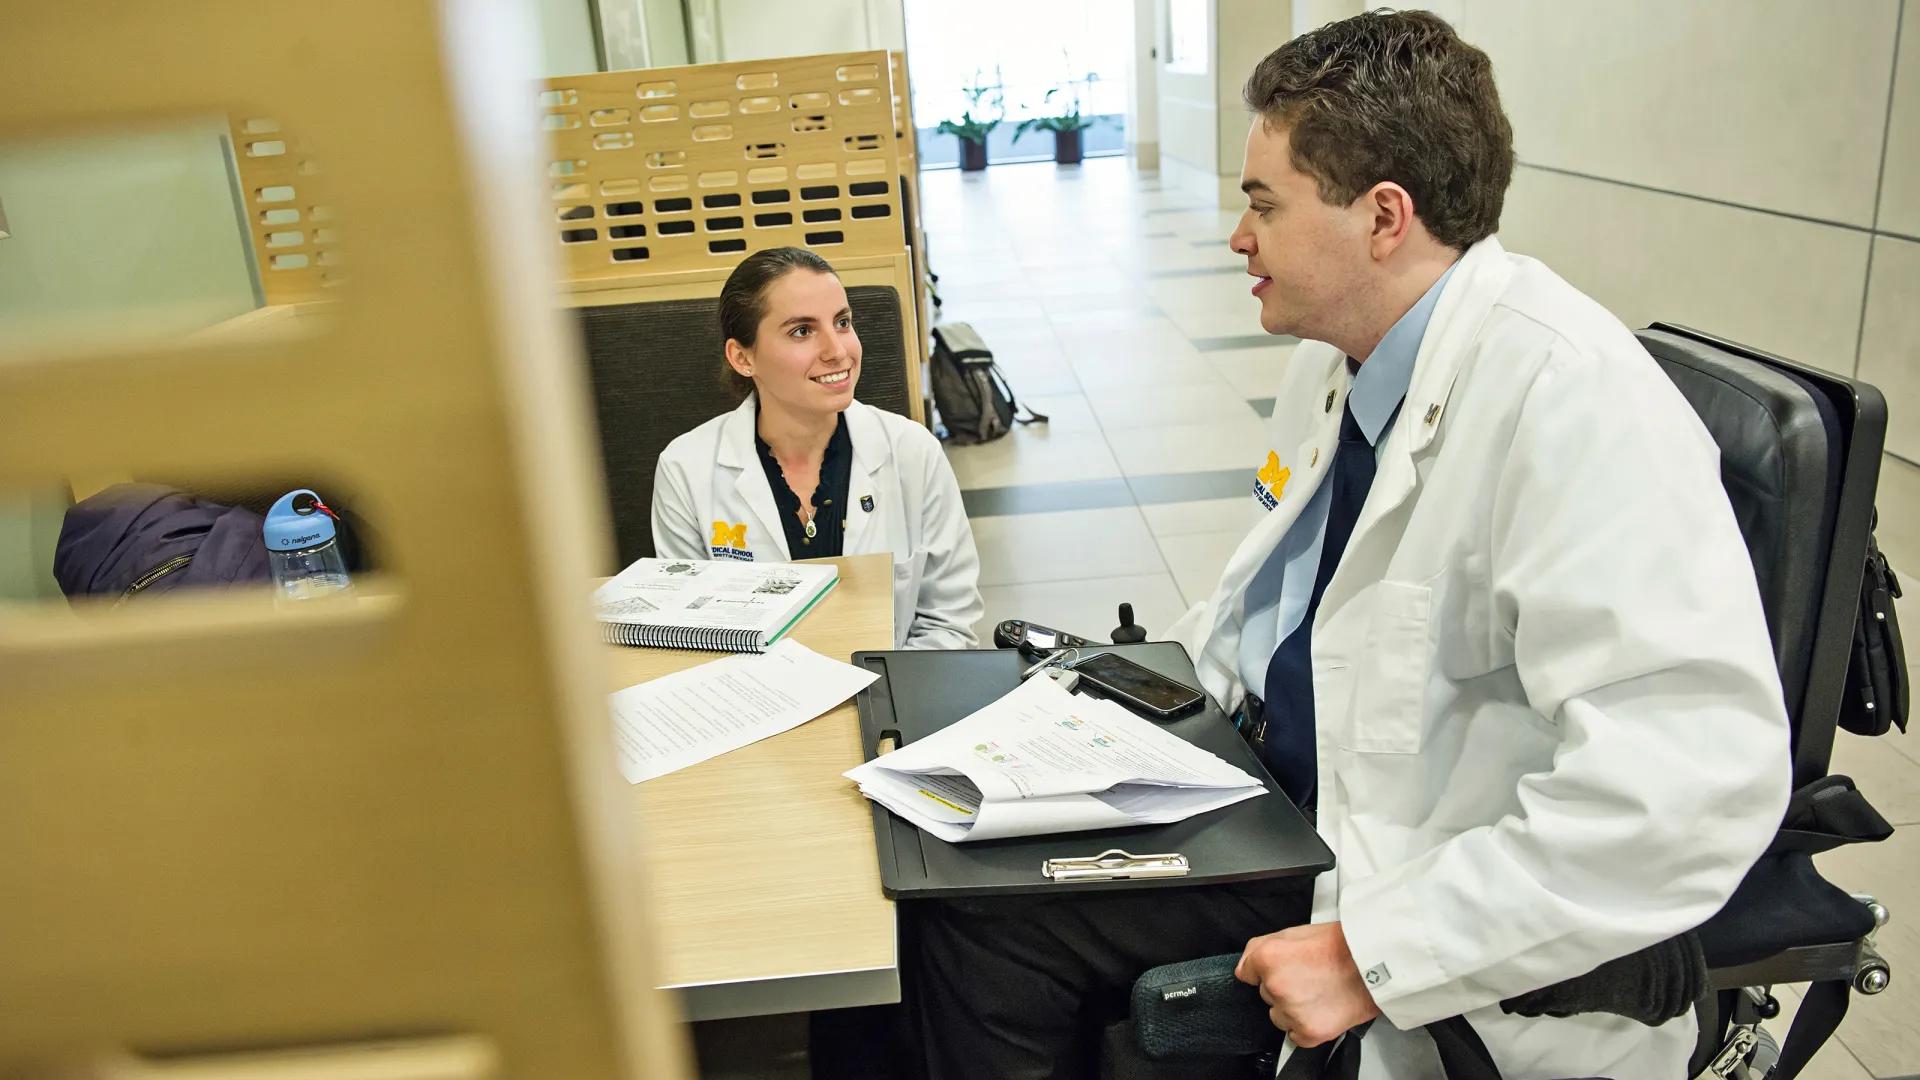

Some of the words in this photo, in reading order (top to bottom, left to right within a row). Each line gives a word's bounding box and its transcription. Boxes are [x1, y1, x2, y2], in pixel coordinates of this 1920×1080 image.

[1256, 449, 1291, 501] M
[1263, 491, 1279, 508] SCHO
[711, 520, 747, 549] M
[731, 548, 754, 558] SCHOOL
